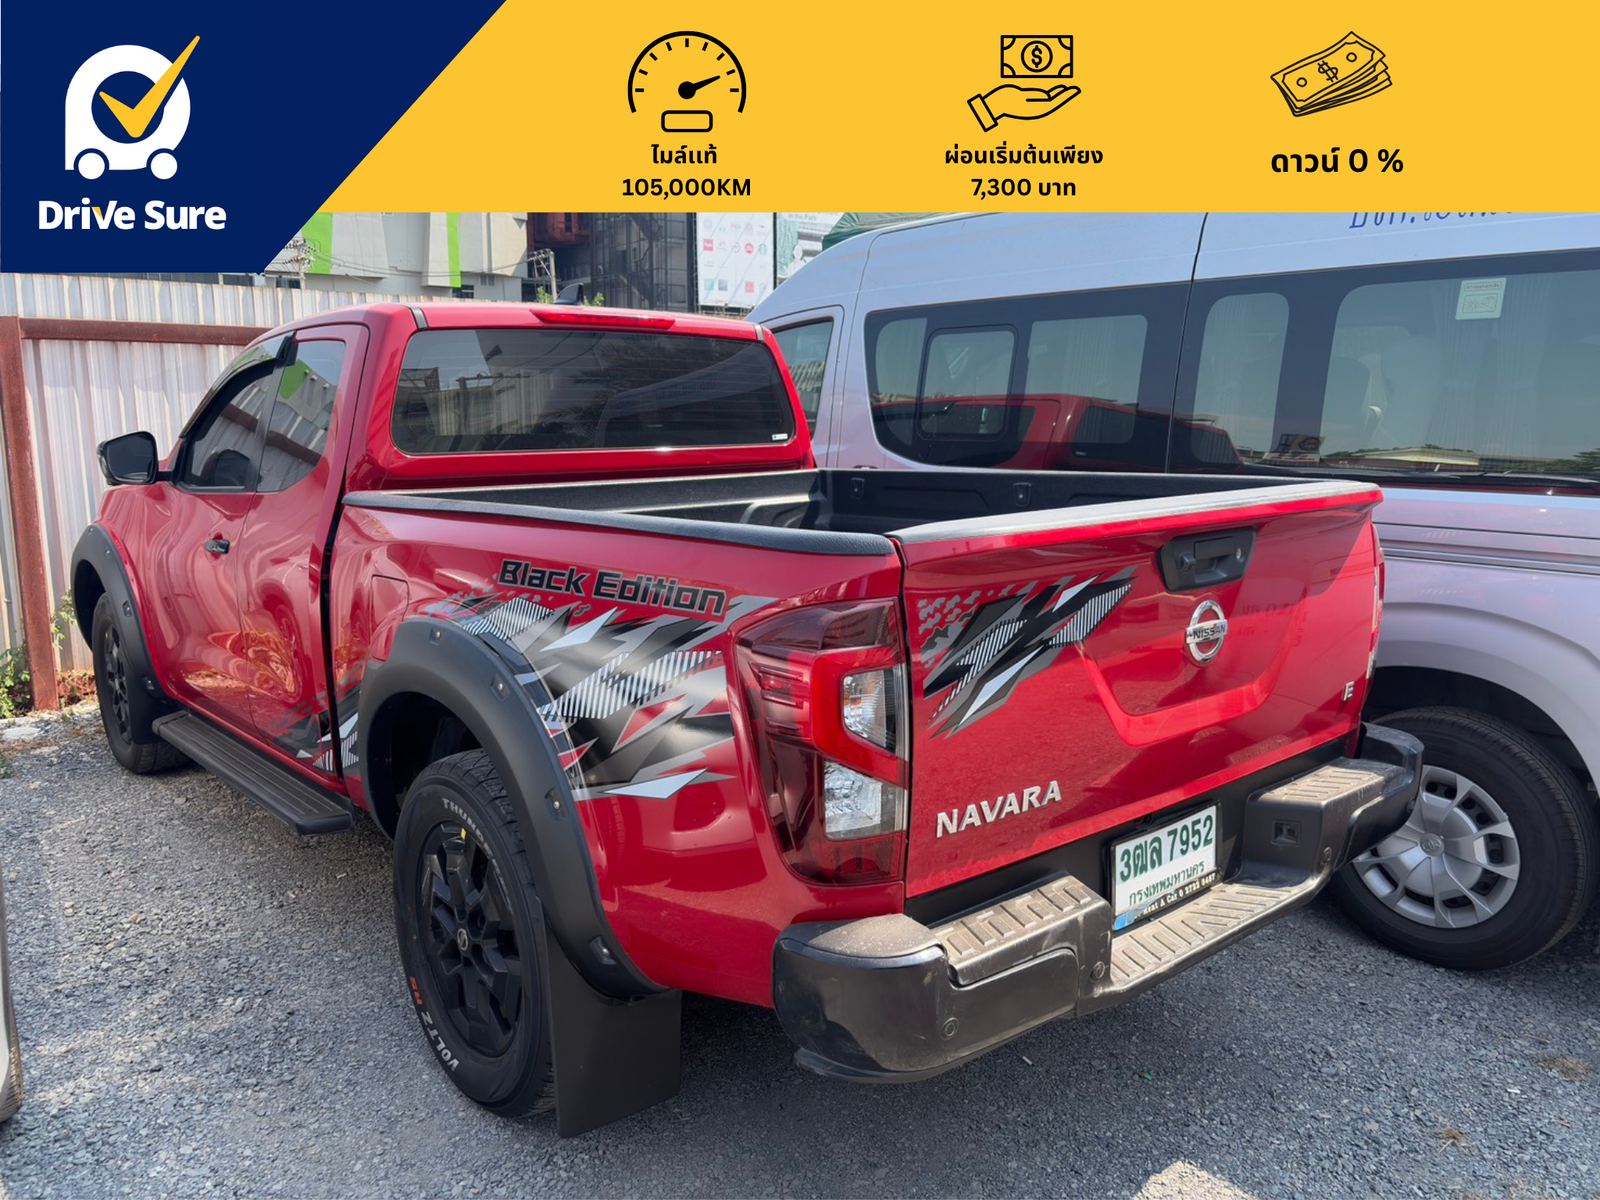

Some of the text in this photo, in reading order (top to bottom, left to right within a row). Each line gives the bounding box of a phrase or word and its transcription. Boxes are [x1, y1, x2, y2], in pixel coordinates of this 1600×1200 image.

[498, 558, 727, 617] Black Edition
[1193, 625, 1226, 639] NISSAN
[936, 780, 1062, 838] NAVARA
[1167, 814, 1213, 862] 7952
[1129, 861, 1204, 906] กรงเทพมหานคร
[421, 1010, 459, 1072] VOLTZ
